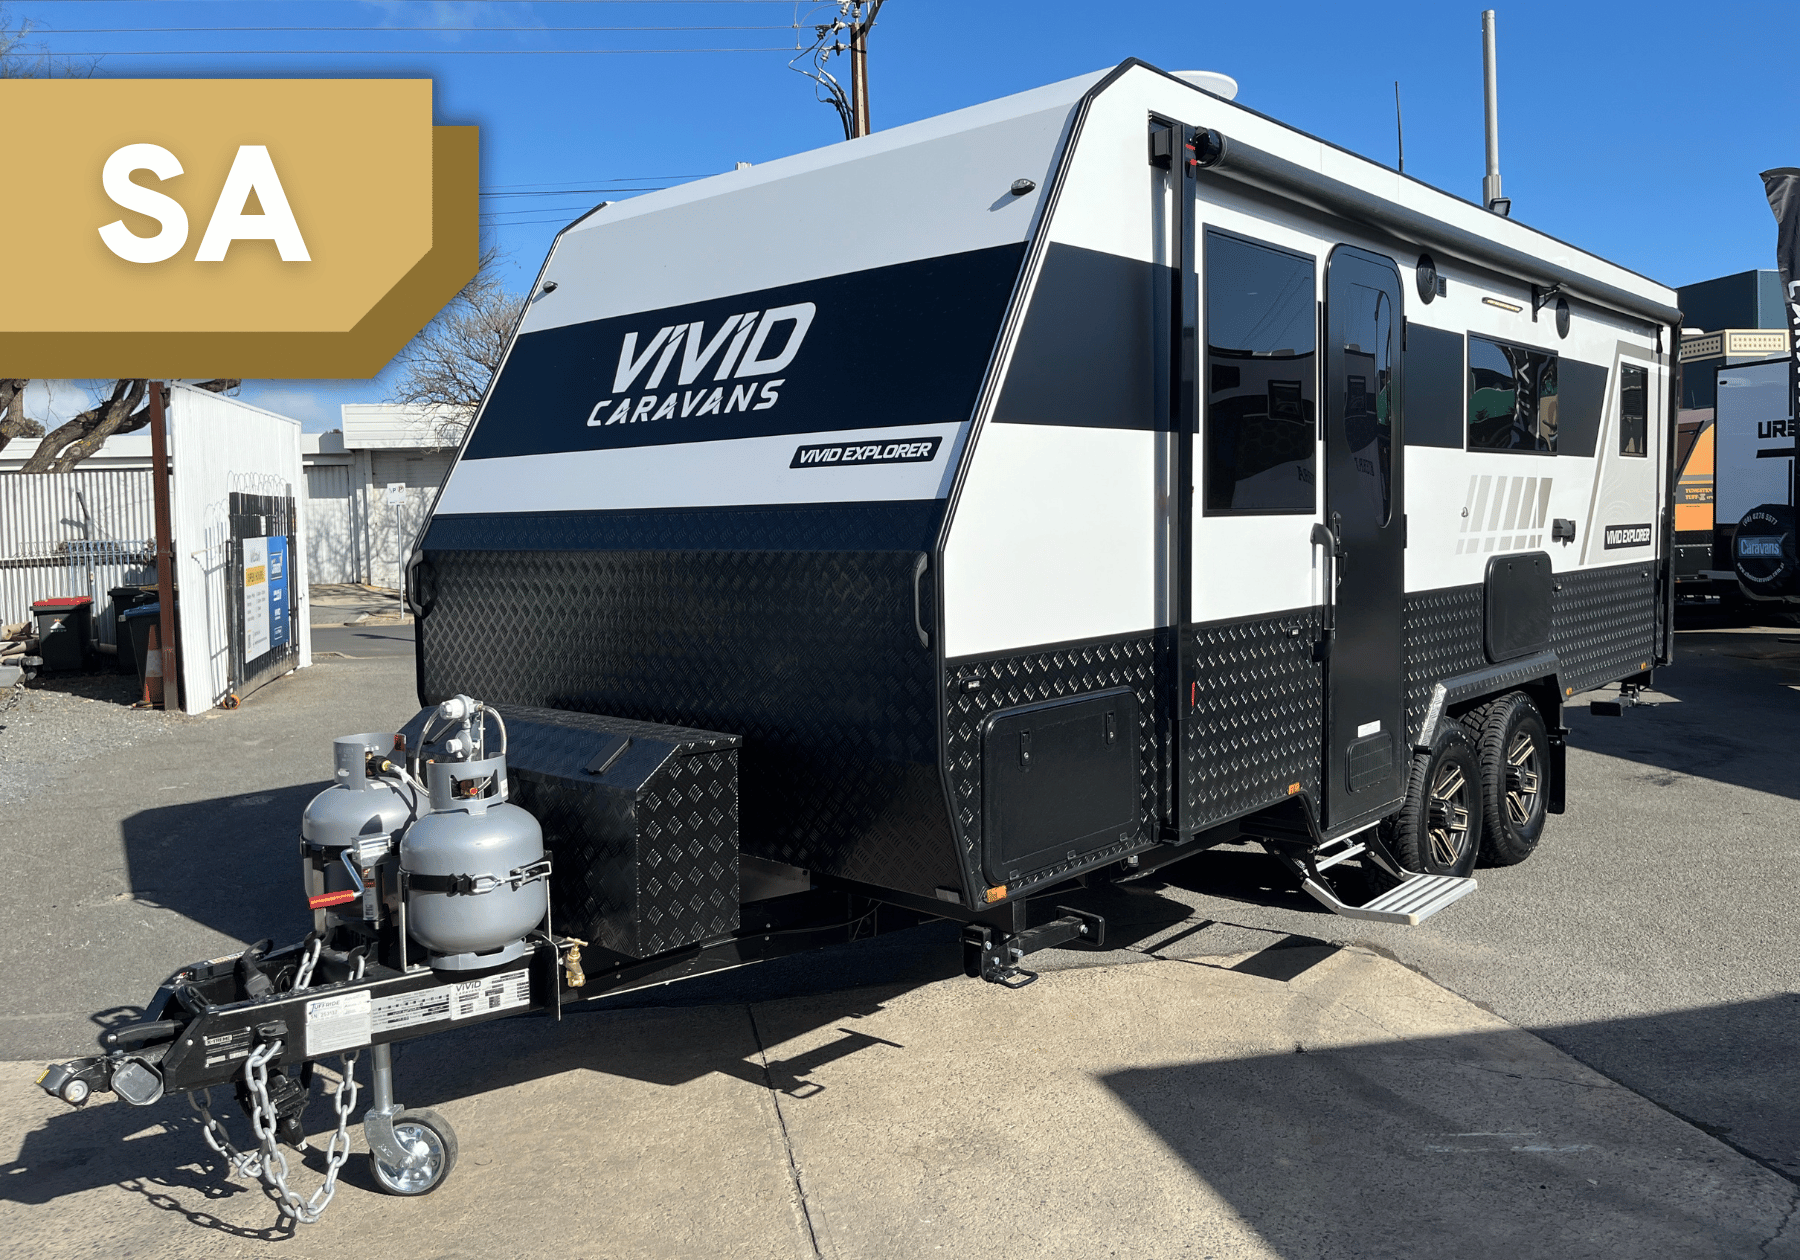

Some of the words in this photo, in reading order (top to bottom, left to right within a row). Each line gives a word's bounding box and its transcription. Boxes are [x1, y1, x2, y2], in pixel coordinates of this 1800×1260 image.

[612, 302, 816, 393] VIVID
[587, 379, 786, 427] CARAVANS
[800, 448, 843, 463] VIVID
[841, 442, 932, 461] EXPLORER
[1606, 530, 1623, 545] VIVID
[1622, 528, 1651, 543] EXPLORER
[1740, 539, 1780, 554] Caravans
[456, 981, 482, 992] VIVID
